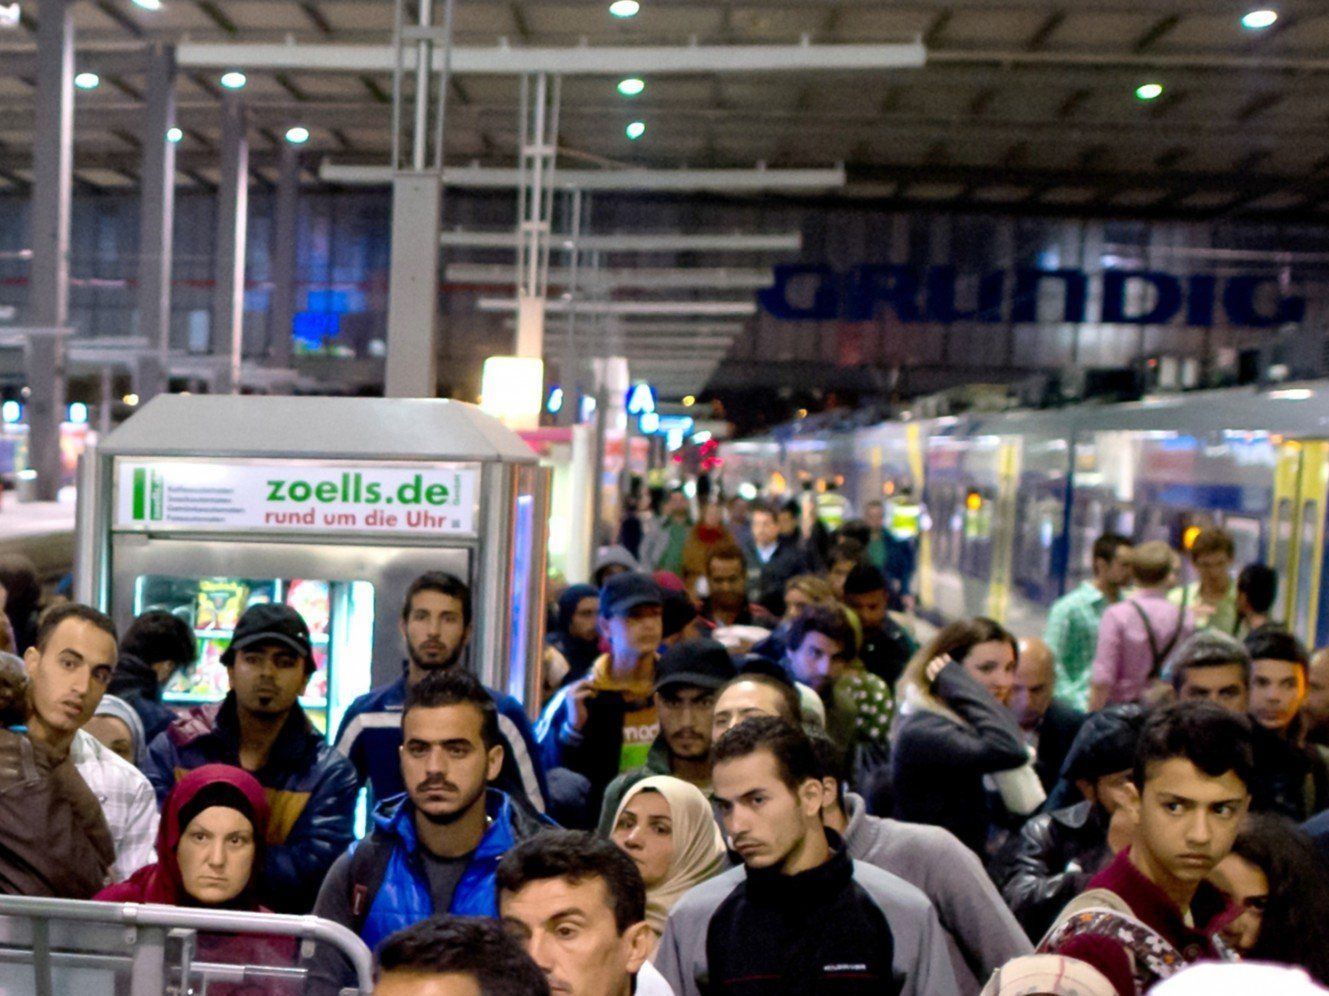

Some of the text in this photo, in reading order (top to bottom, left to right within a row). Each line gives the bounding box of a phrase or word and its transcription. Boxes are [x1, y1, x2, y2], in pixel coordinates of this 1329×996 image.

[266, 472, 450, 506] zoells.de
[264, 507, 315, 525] rund
[323, 511, 356, 527] um
[364, 509, 397, 527] die
[406, 511, 447, 528] Uhr
